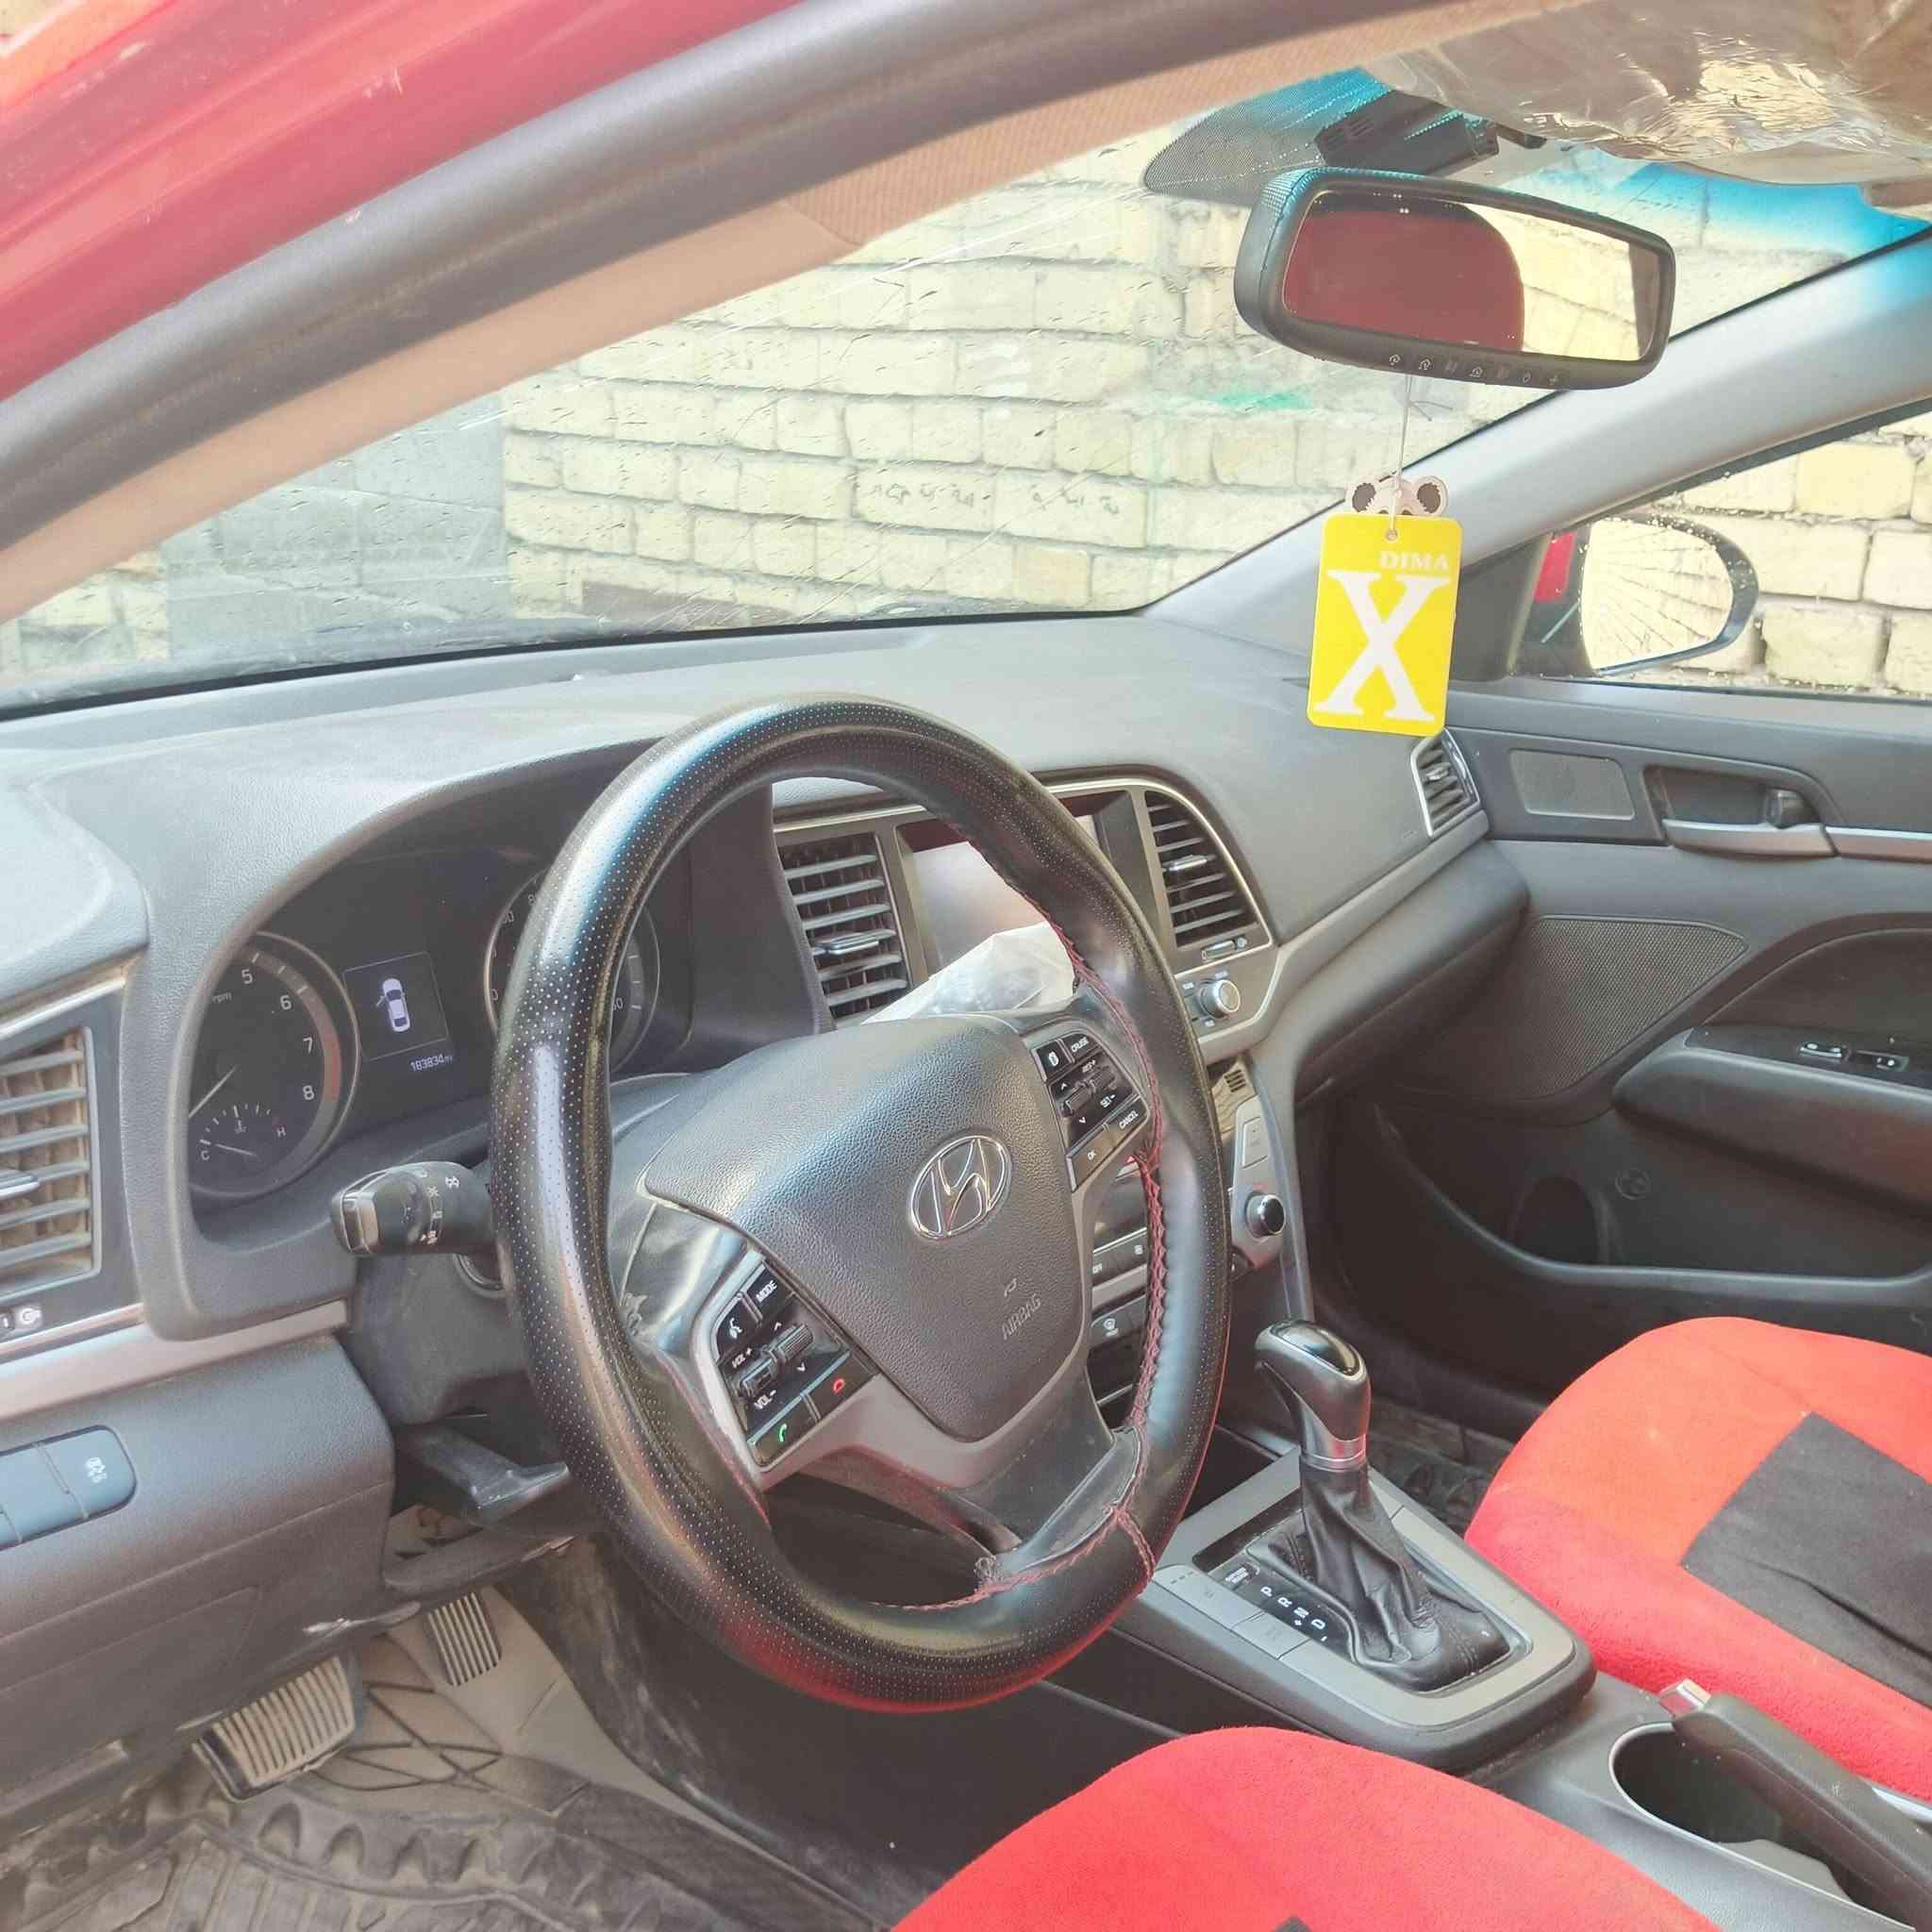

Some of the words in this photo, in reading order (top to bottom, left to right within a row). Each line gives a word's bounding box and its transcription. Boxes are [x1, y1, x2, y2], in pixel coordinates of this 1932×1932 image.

[1378, 550, 1451, 571] DIMA
[1313, 570, 1451, 722] X
[242, 968, 253, 985] 5
[279, 993, 292, 1010] 6
[303, 1037, 314, 1054] 7
[302, 1084, 315, 1101] 8
[200, 1149, 211, 1161] C
[756, 1279, 778, 1303] MODE
[1259, 1586, 1273, 1597] P
[1277, 1596, 1292, 1607] R
[1293, 1607, 1309, 1619] N
[1310, 1618, 1326, 1630] D
